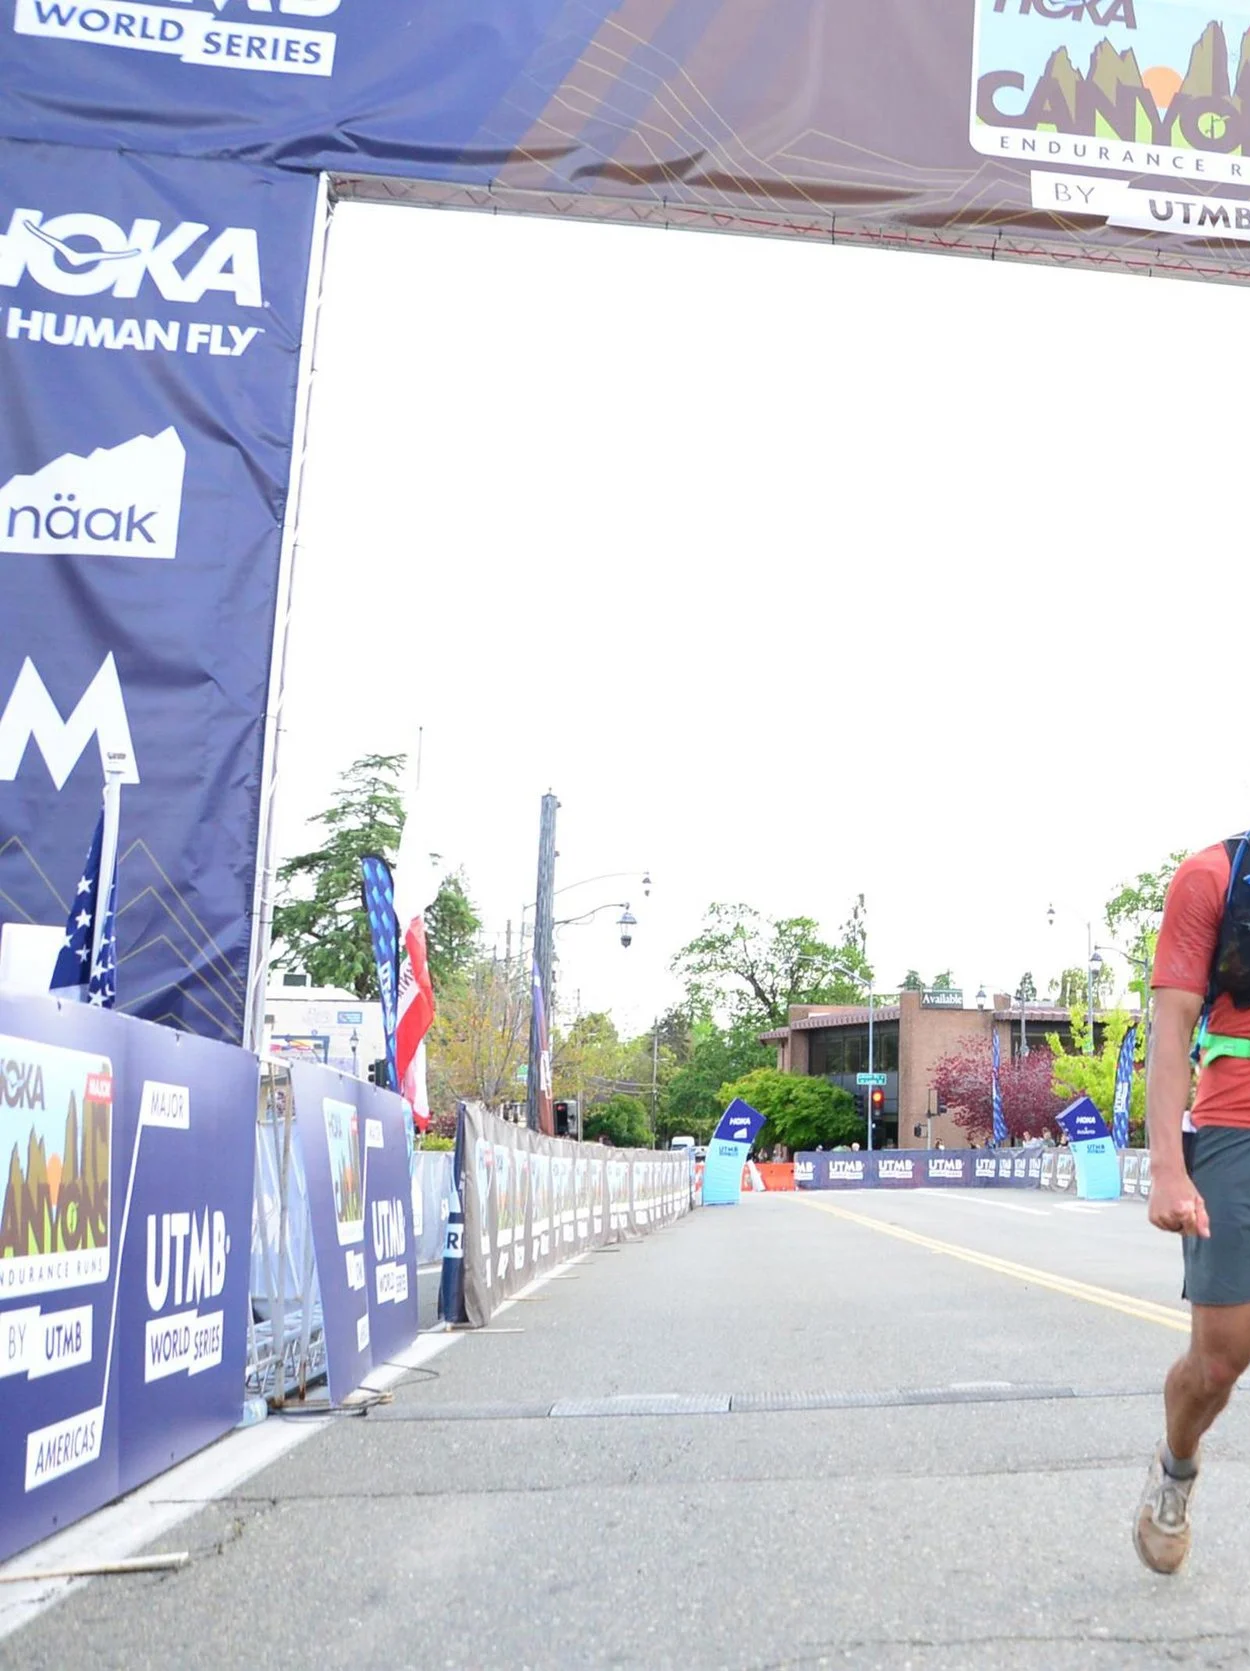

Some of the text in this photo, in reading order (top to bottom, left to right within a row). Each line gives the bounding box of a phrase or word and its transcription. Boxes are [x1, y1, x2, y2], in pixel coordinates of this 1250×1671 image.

[35, 0, 185, 42] WORLD
[201, 31, 322, 65] SERIES
[1000, 134, 1206, 173] ENDURANCE
[1054, 182, 1095, 204] BY
[6, 307, 258, 356] HUMAN FLY
[6, 493, 159, 544] näak
[0, 1058, 46, 1112] OKA
[150, 1091, 185, 1120] MAJOR
[829, 1160, 864, 1172] UTMB
[878, 1160, 914, 1171] UTMB
[928, 1158, 964, 1170] UTMB
[146, 1204, 227, 1312] UTMB
[8, 1321, 83, 1361] BY UTMB
[150, 1324, 221, 1365] WORLD SERIES
[34, 1420, 97, 1478] AMERICAS
